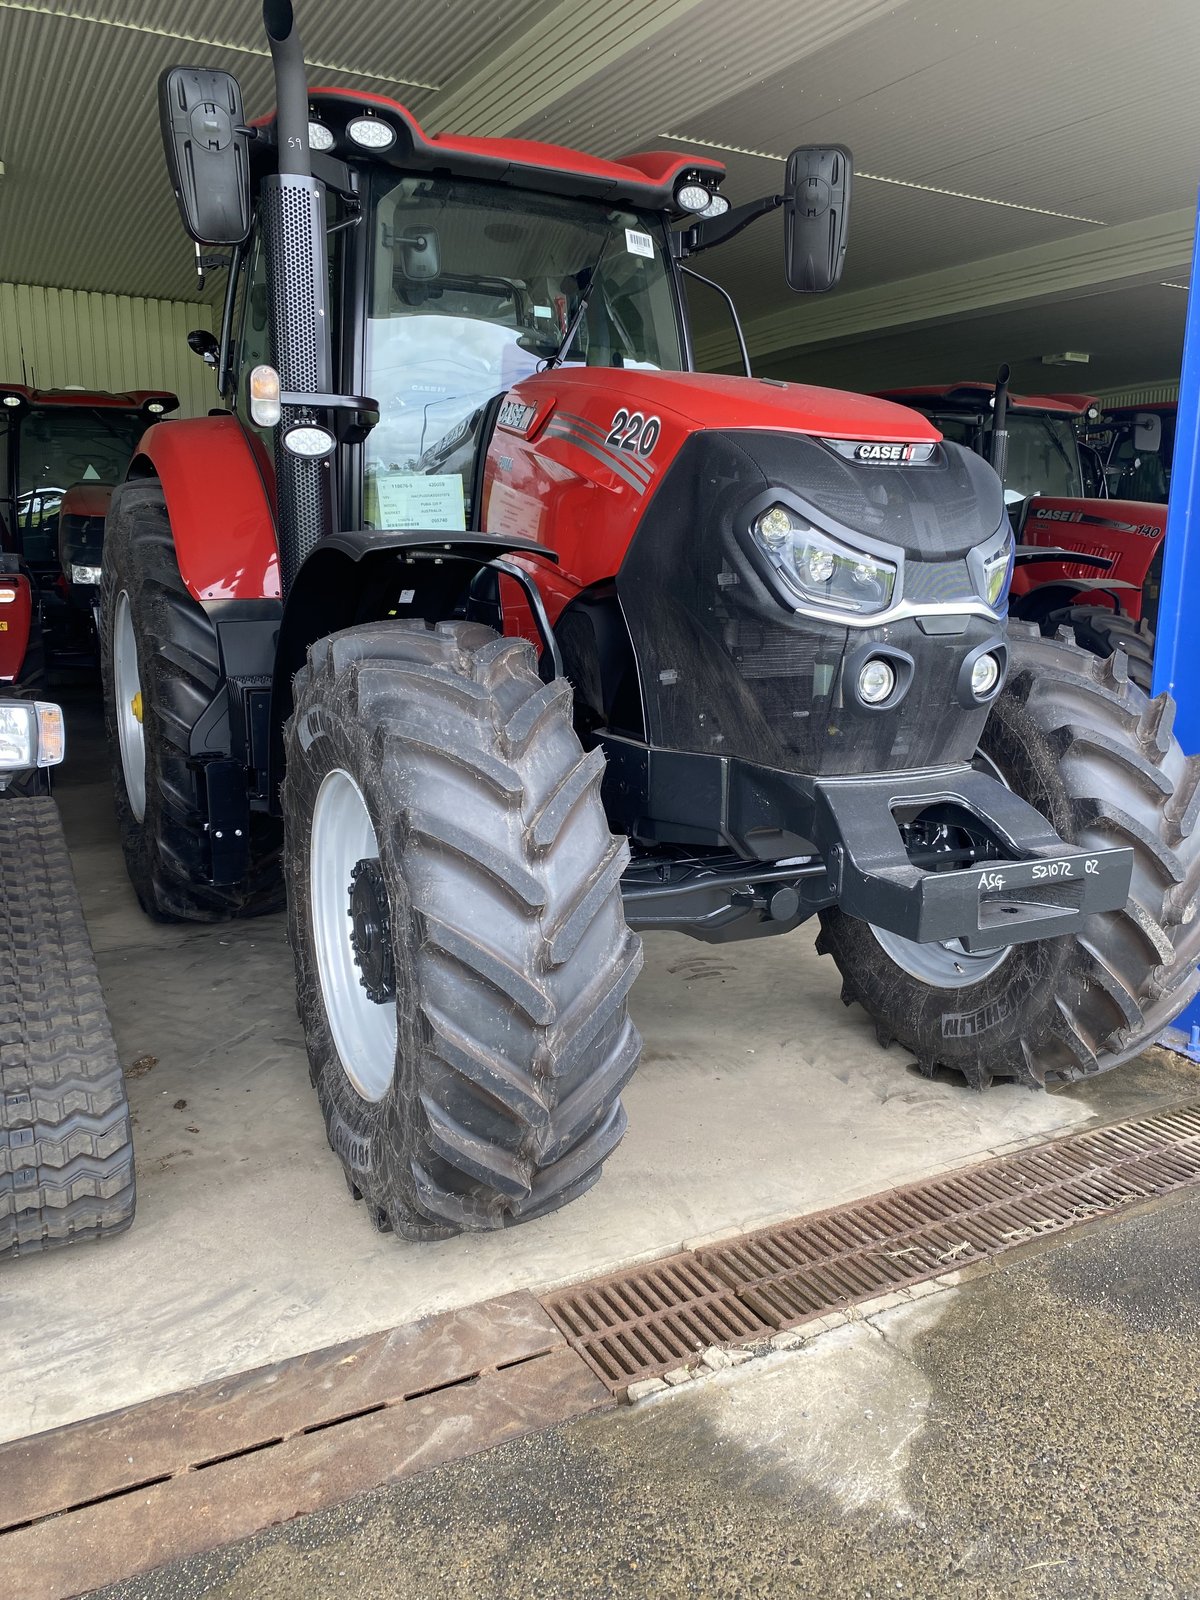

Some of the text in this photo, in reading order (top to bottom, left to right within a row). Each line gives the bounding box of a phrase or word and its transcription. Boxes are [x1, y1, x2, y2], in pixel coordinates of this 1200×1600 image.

[287, 136, 303, 151] 59
[604, 407, 662, 458] 220
[1136, 524, 1162, 539] 140
